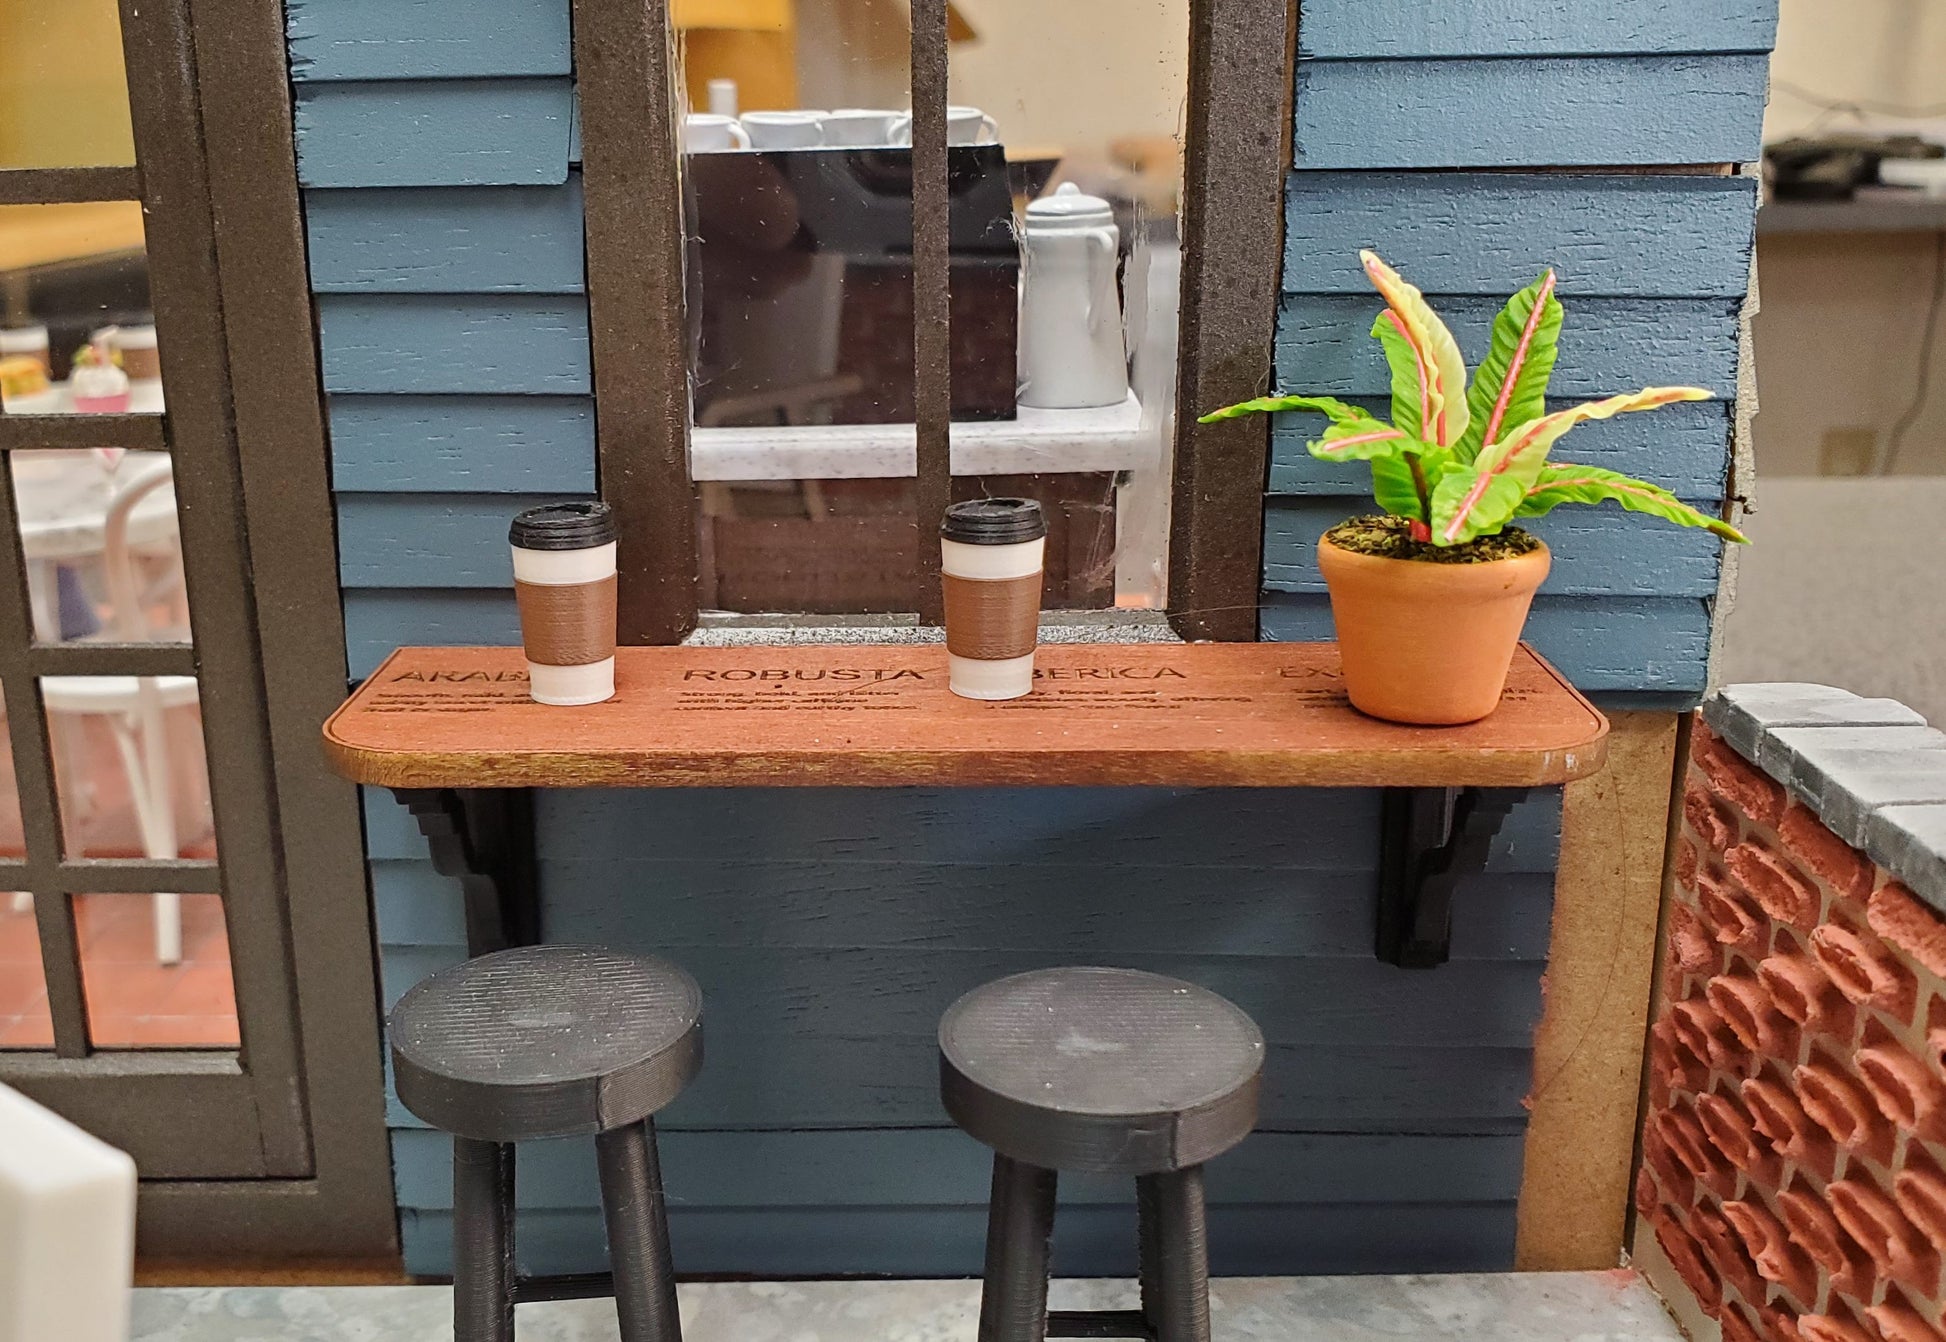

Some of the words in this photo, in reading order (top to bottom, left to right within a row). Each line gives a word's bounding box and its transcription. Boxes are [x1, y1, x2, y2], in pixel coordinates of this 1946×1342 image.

[391, 670, 531, 682] ARAB
[683, 669, 925, 681] ROBUSTA
[1032, 667, 1187, 679] BERICA
